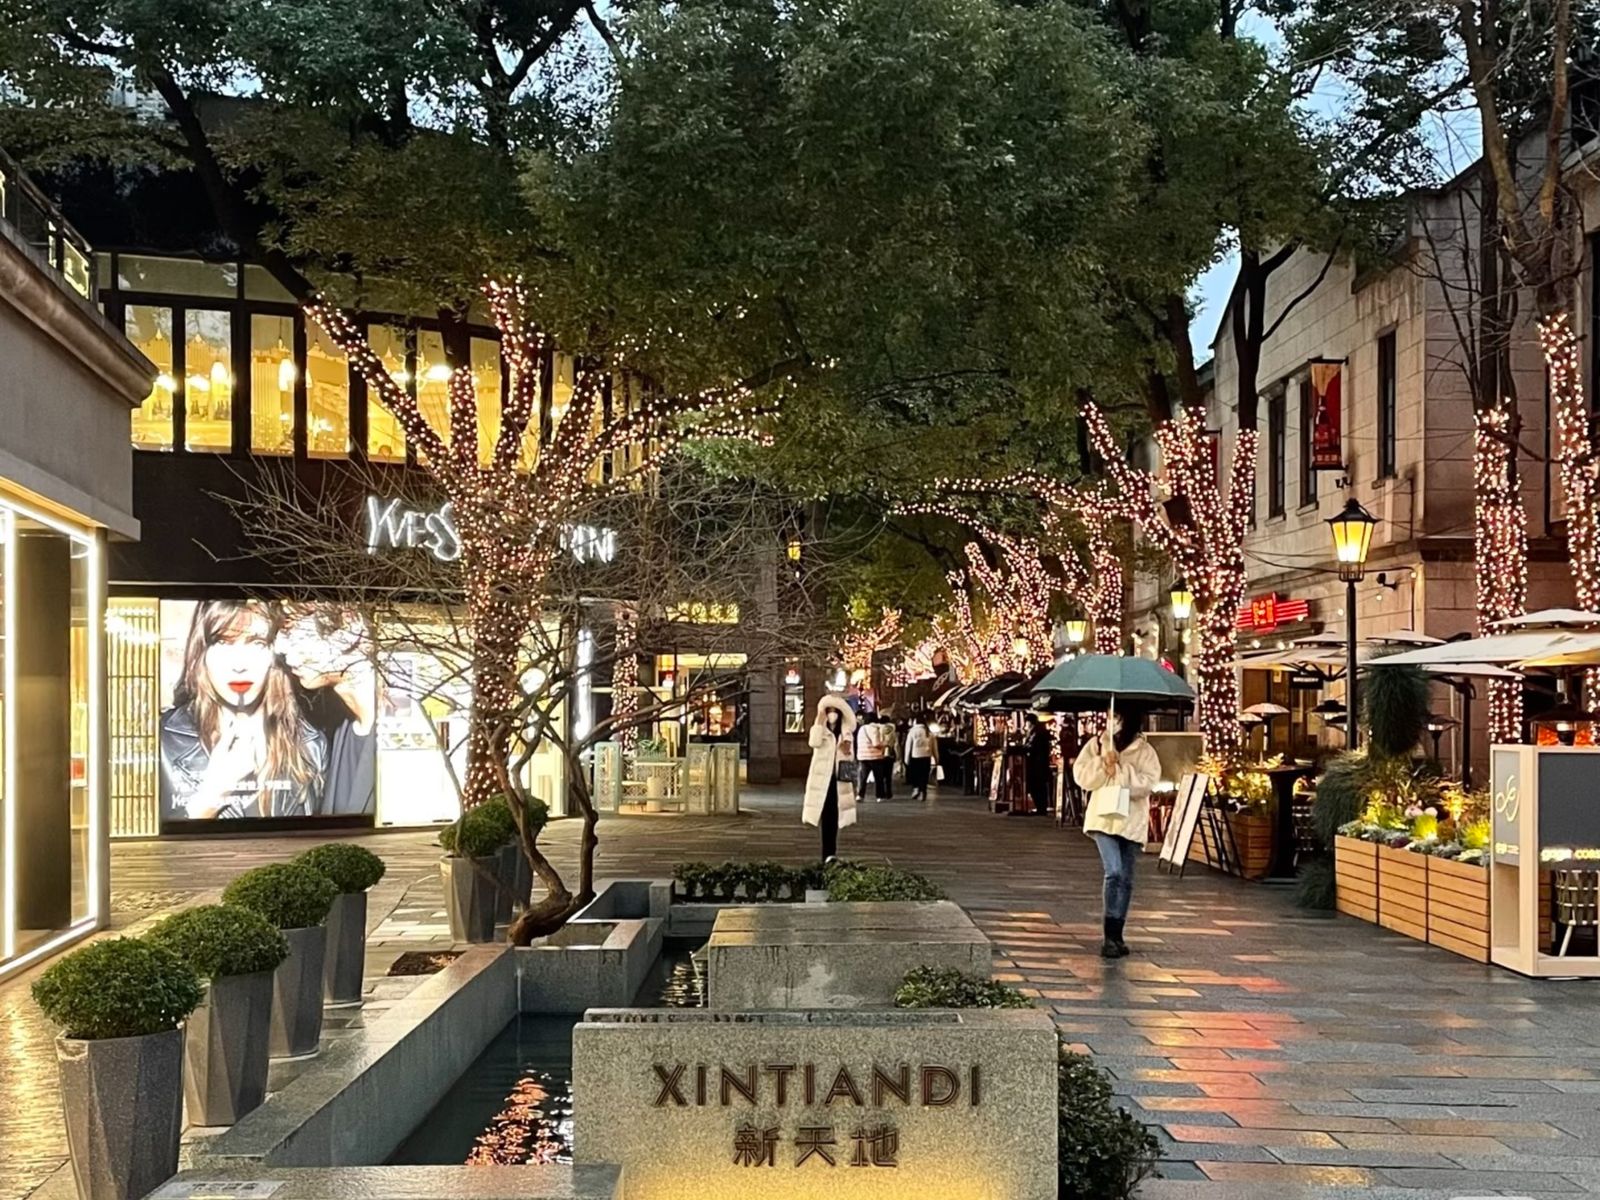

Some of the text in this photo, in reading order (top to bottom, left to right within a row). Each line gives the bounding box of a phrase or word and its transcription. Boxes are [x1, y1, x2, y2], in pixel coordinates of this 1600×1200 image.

[653, 1063, 979, 1106] XINTIANDI
[733, 1123, 898, 1167] 新天地
